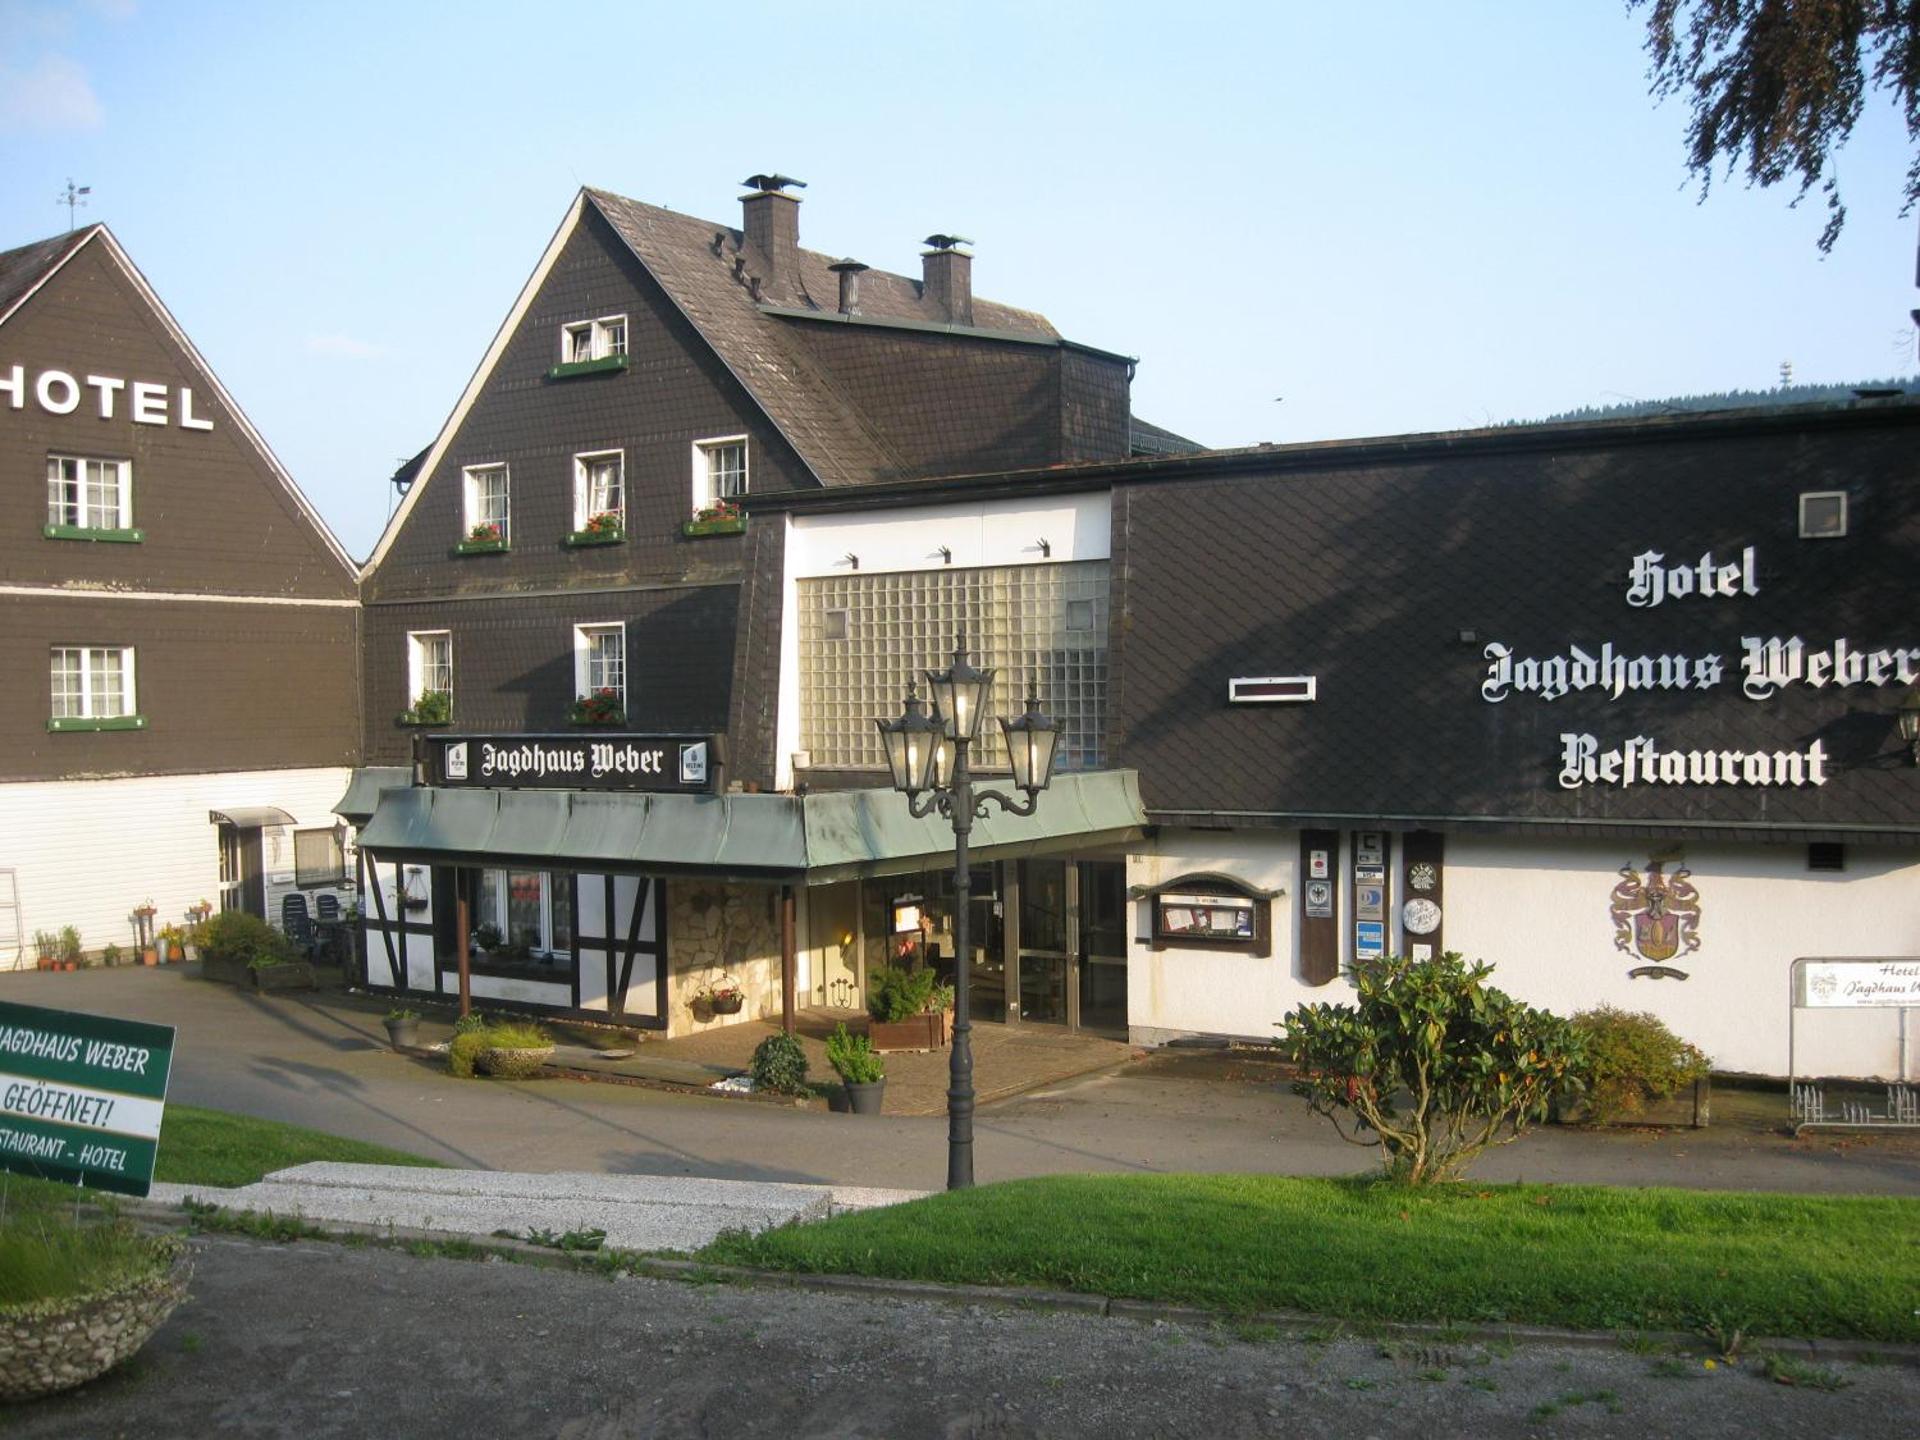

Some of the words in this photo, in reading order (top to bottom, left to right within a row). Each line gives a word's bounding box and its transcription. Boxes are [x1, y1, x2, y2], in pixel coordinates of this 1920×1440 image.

[1626, 546, 1760, 608] Hotel
[1481, 641, 1724, 703] Jagdhaus
[1741, 636, 1920, 701] Weber
[481, 743, 585, 777] Jagdhaus
[591, 743, 663, 778] Weber
[85, 1040, 150, 1075] WEBER
[3, 1081, 115, 1128] GEÖFFNET!
[79, 1144, 128, 1172] HOTEL
